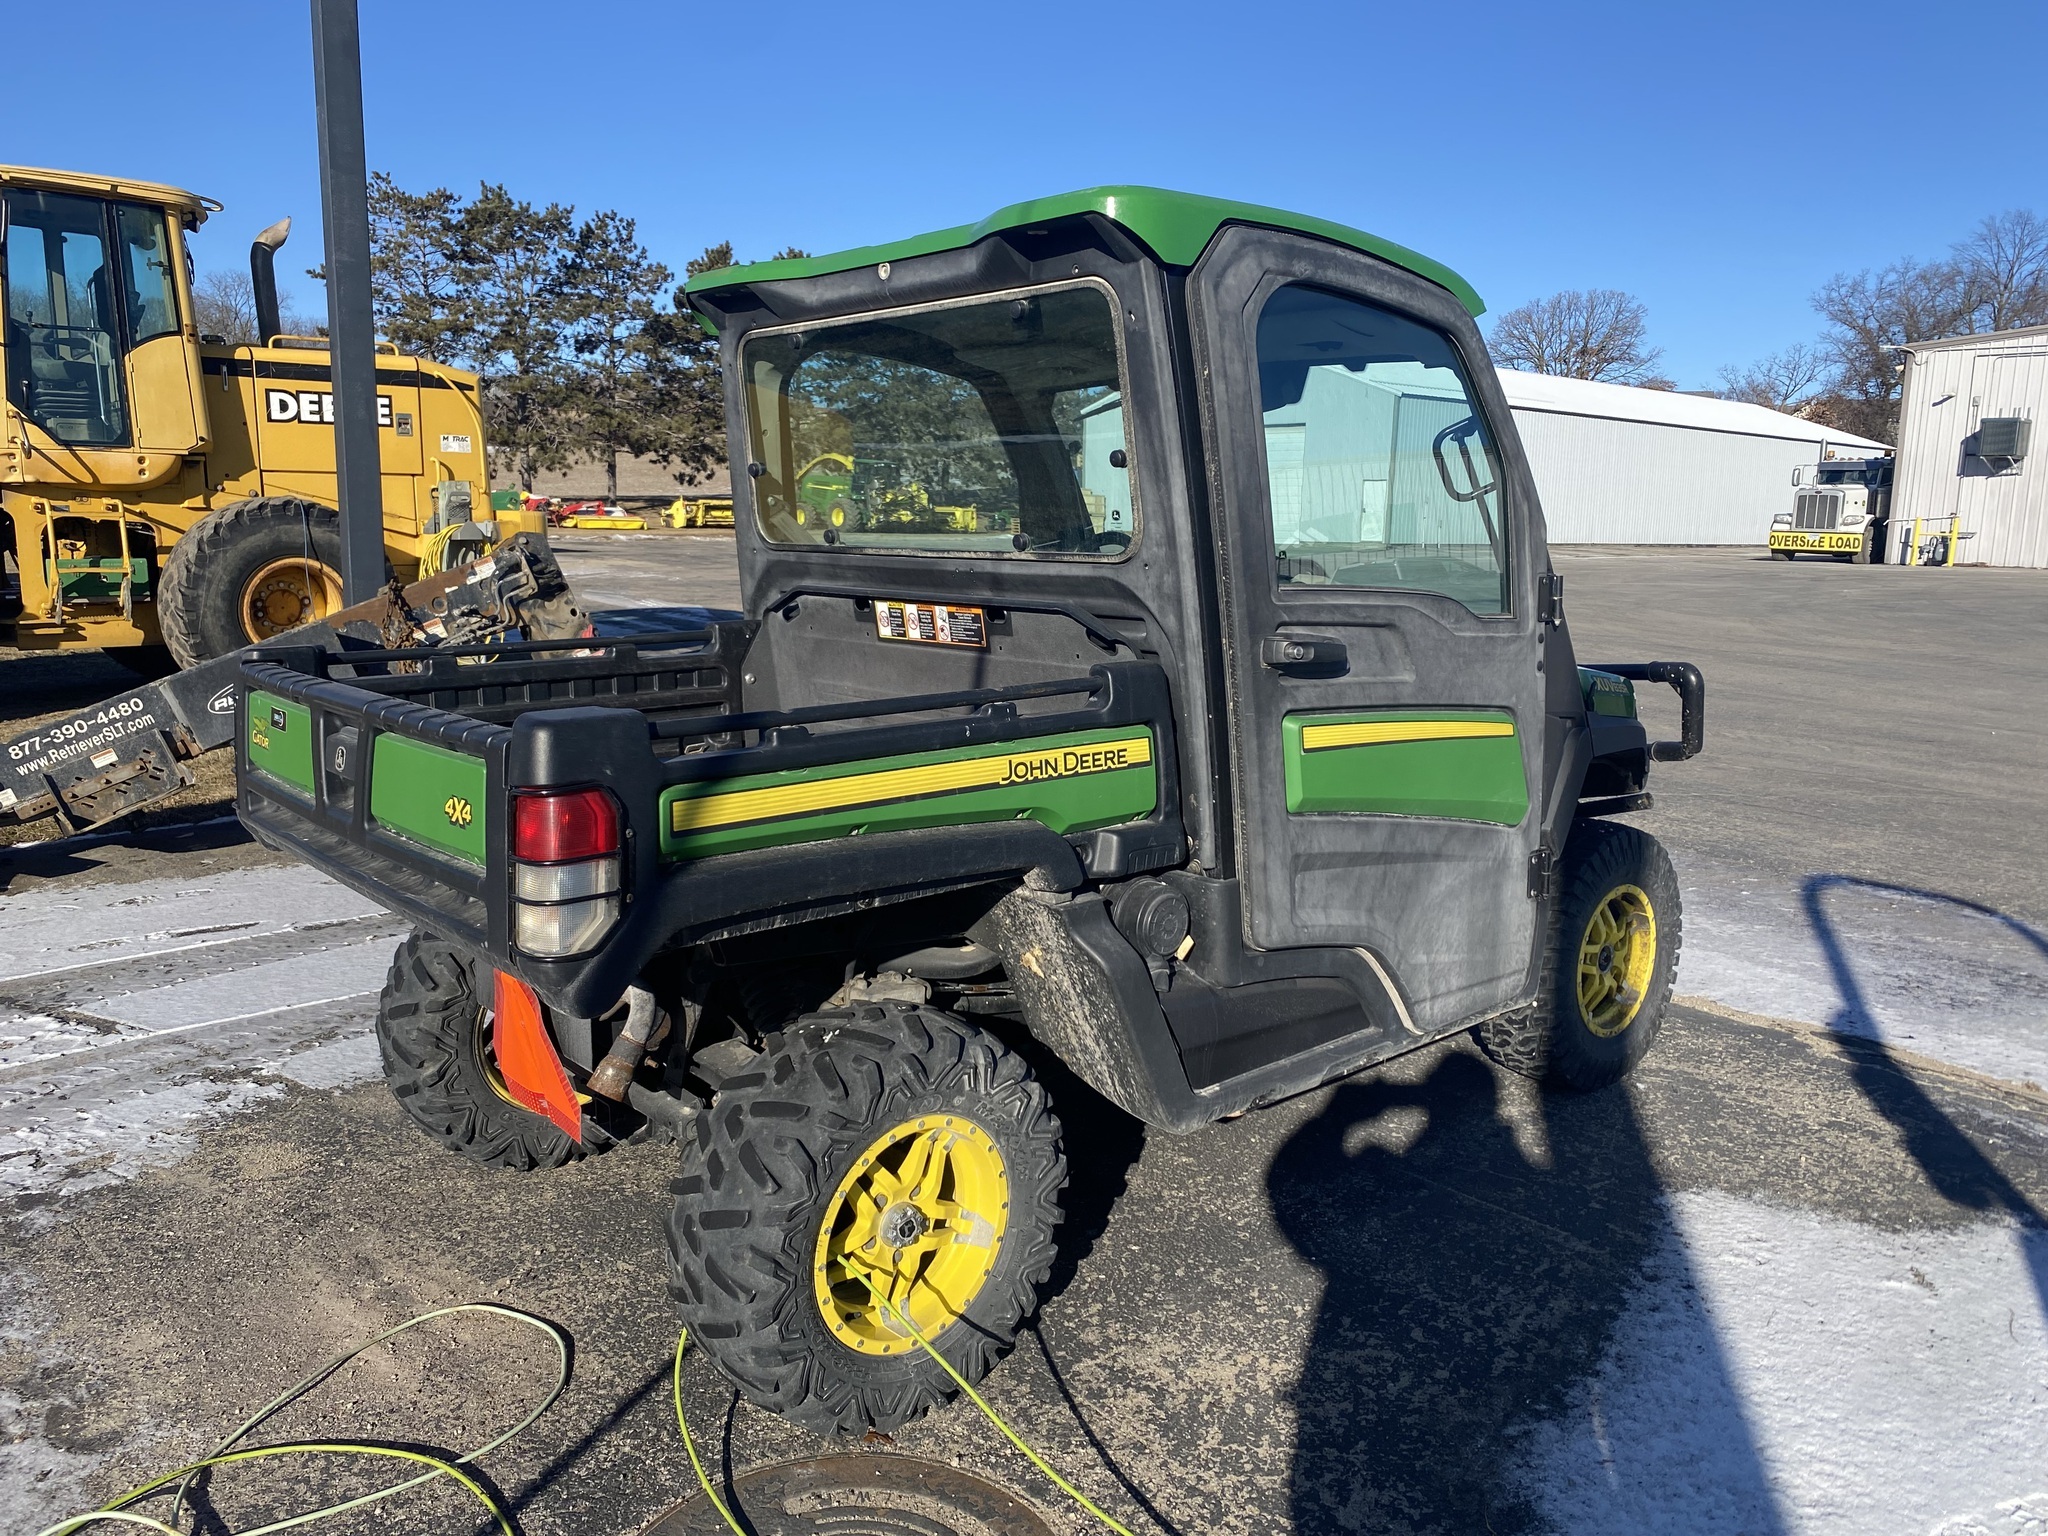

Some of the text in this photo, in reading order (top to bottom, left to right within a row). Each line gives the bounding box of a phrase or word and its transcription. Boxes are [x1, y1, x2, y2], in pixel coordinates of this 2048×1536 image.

[267, 390, 391, 426] DEEE
[1769, 534, 1861, 549] OVERSIZE LOAD
[8, 697, 144, 760] 877-390-4480
[15, 713, 156, 776] www.RetrieverSLT.com
[1001, 748, 1128, 782] JOHN DEERE
[444, 796, 472, 826] 4X4
